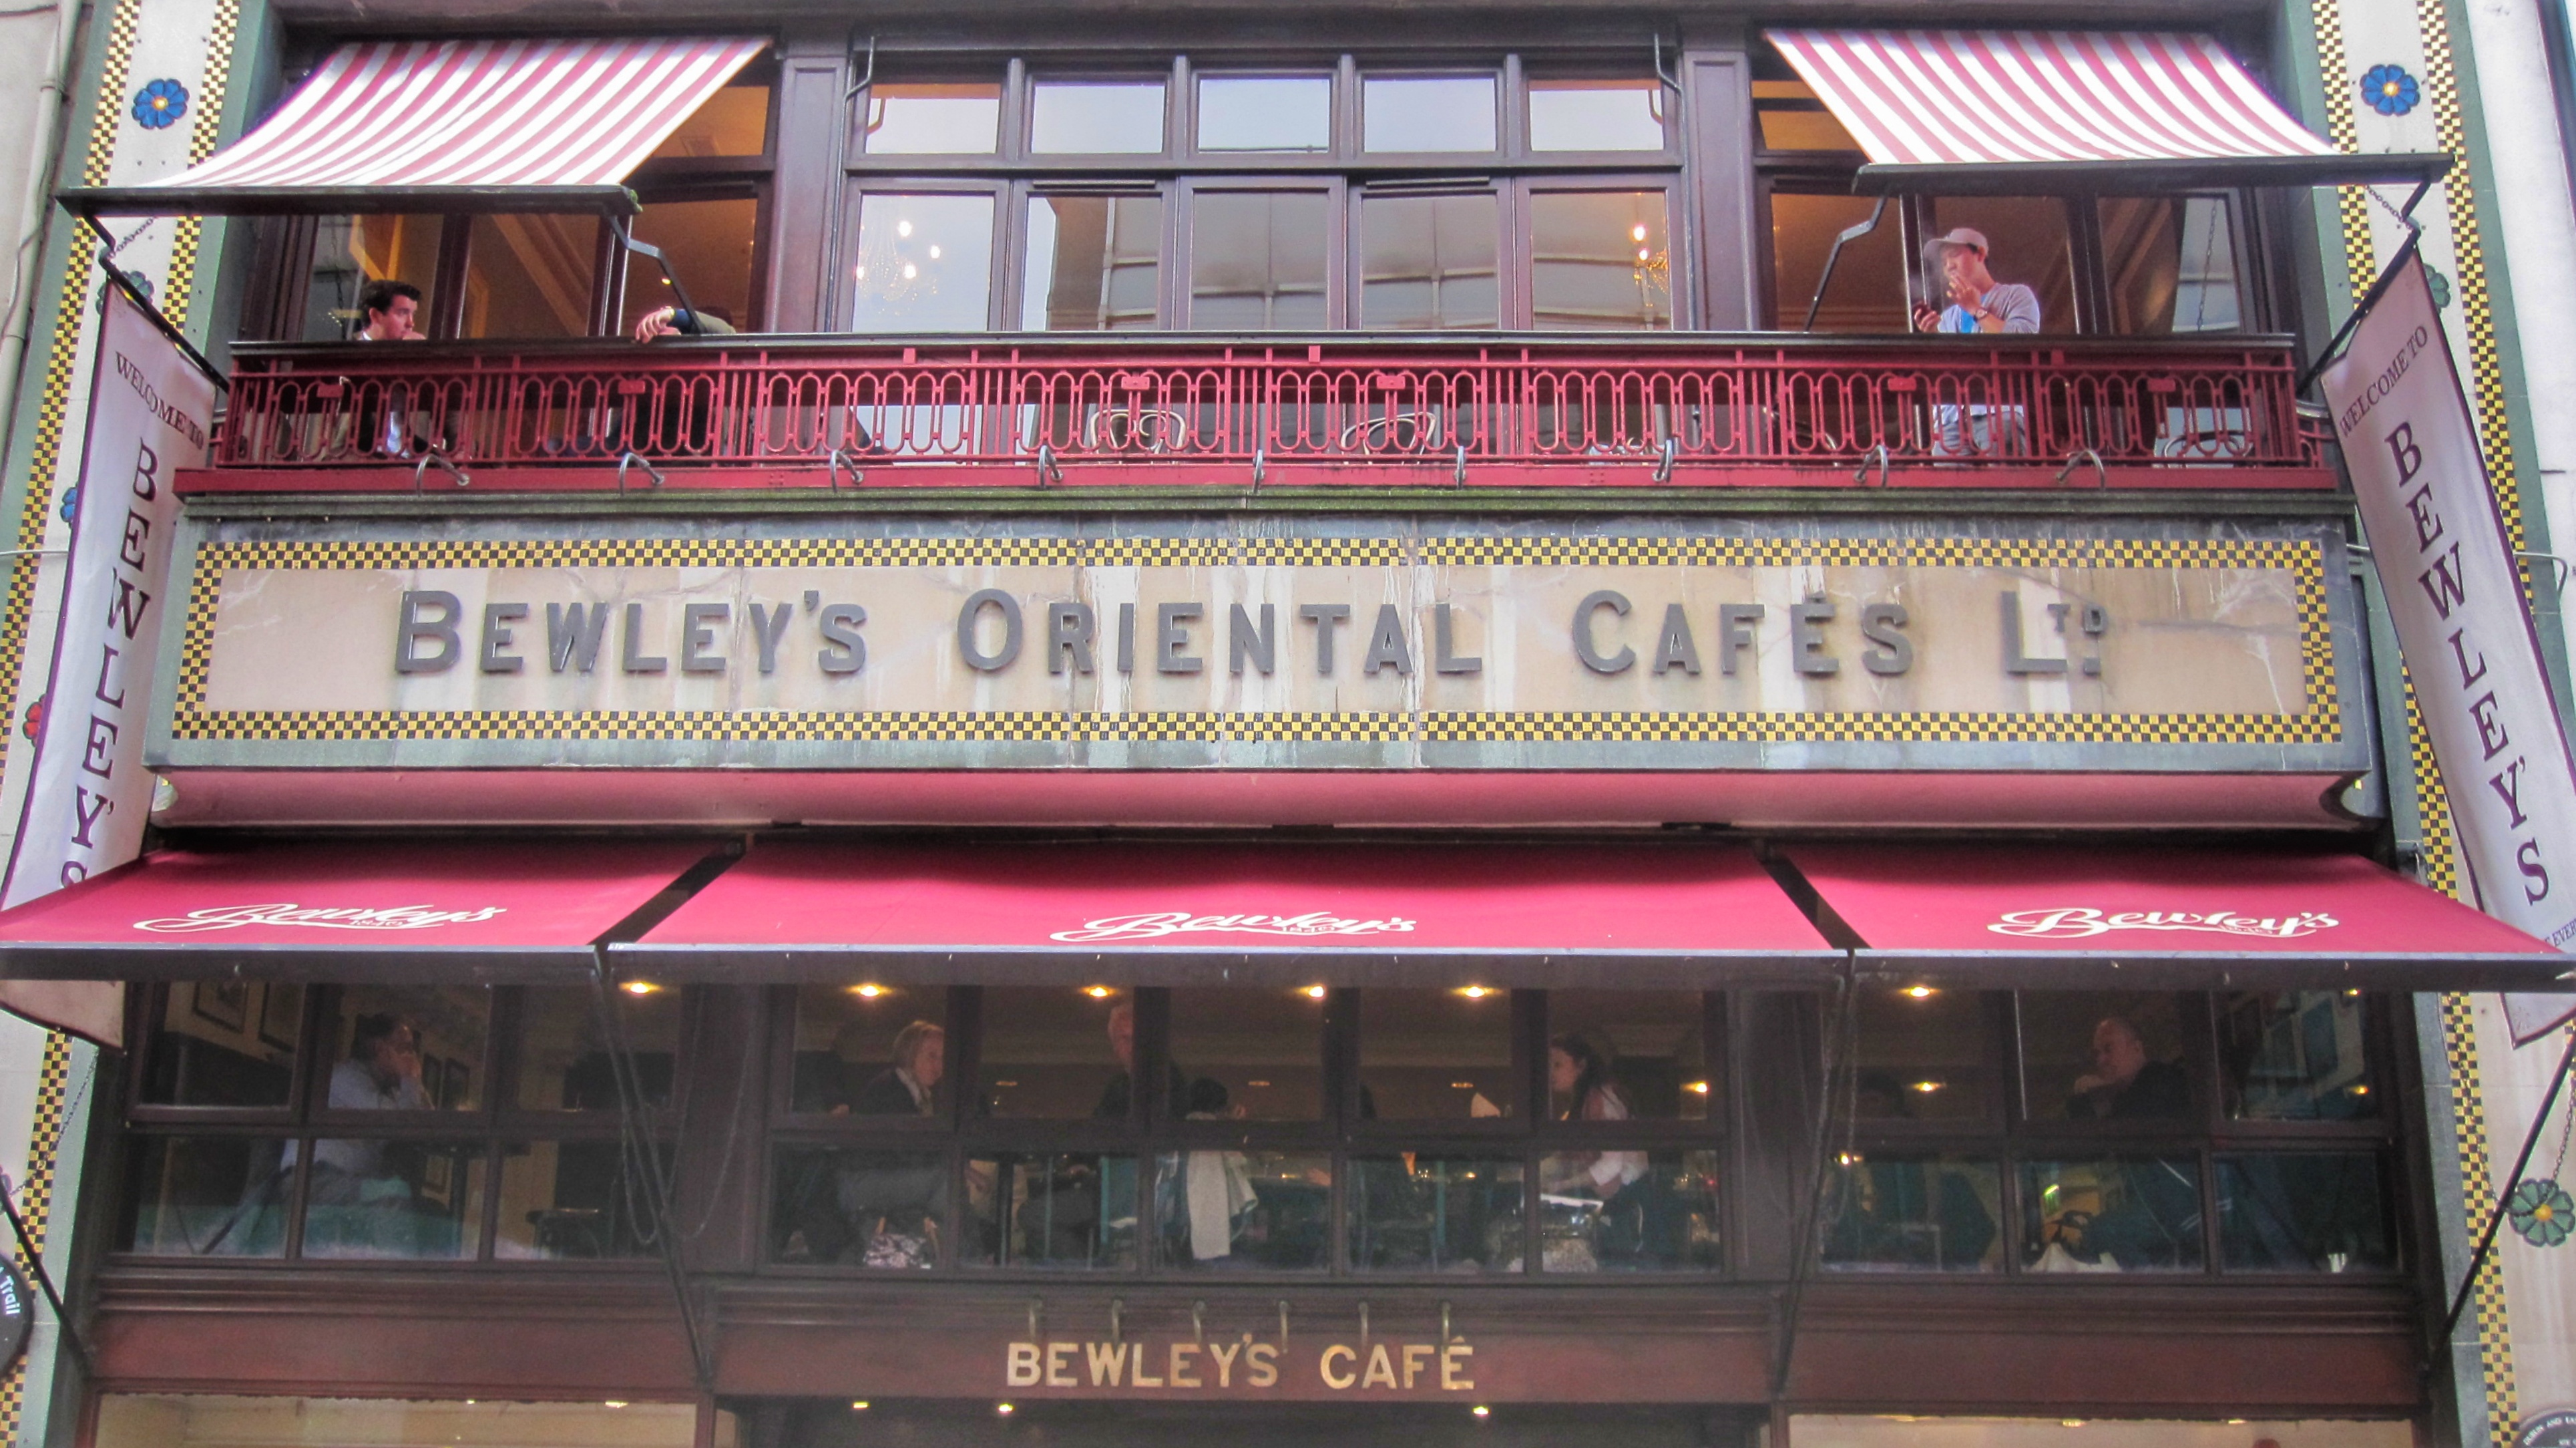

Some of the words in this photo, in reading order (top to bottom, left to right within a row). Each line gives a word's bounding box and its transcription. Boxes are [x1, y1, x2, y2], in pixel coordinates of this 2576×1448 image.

[116, 351, 187, 433] WELCOME
[186, 419, 204, 450] TO
[2340, 349, 2409, 438] WELCOME
[2407, 326, 2428, 359] TO
[957, 588, 1484, 673] ORIENTAL
[1050, 911, 1418, 942] Bewley's
[1987, 907, 2340, 938] Bewley's
[1, 1275, 21, 1315] Trail
